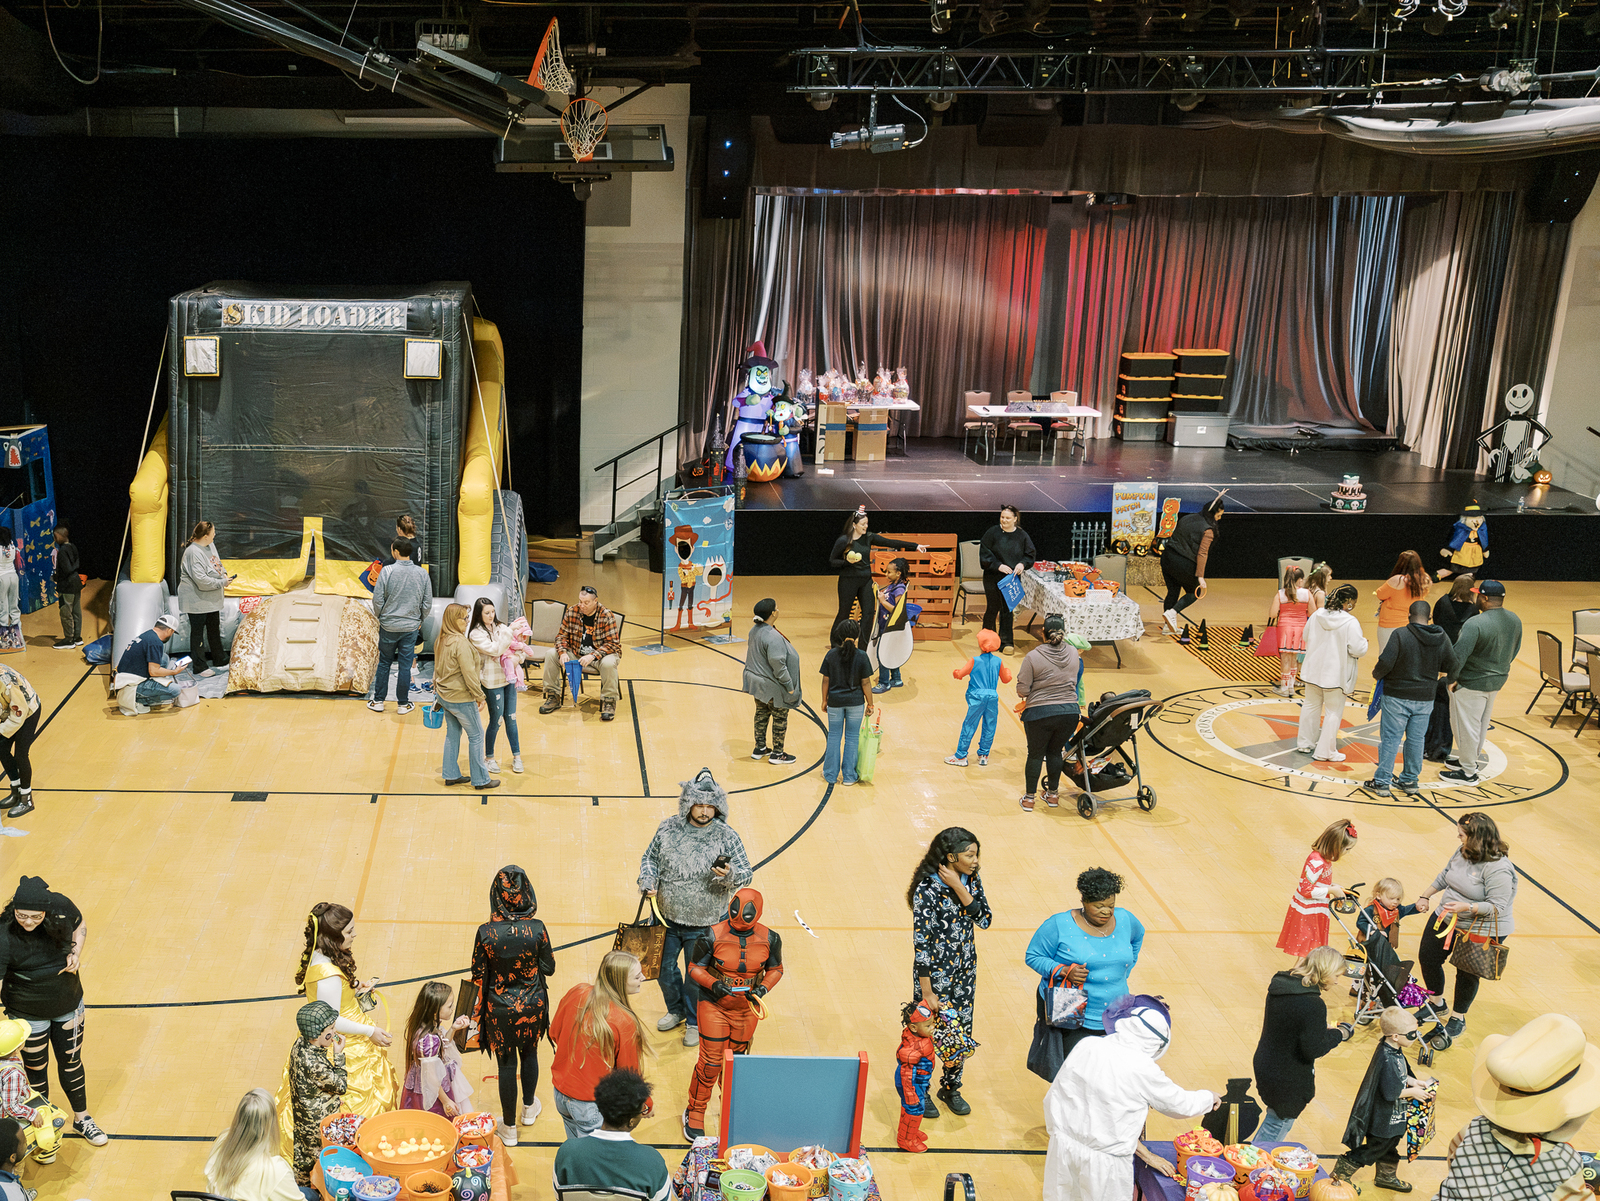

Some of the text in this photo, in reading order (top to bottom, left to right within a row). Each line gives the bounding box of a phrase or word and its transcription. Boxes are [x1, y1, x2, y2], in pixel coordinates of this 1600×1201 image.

[224, 303, 404, 328] SKID LOADER
[1115, 492, 1155, 500] PUMPKIN
[1114, 501, 1141, 514] PATCH
[1113, 518, 1131, 529] CATS
[1158, 694, 1217, 725] CITY
